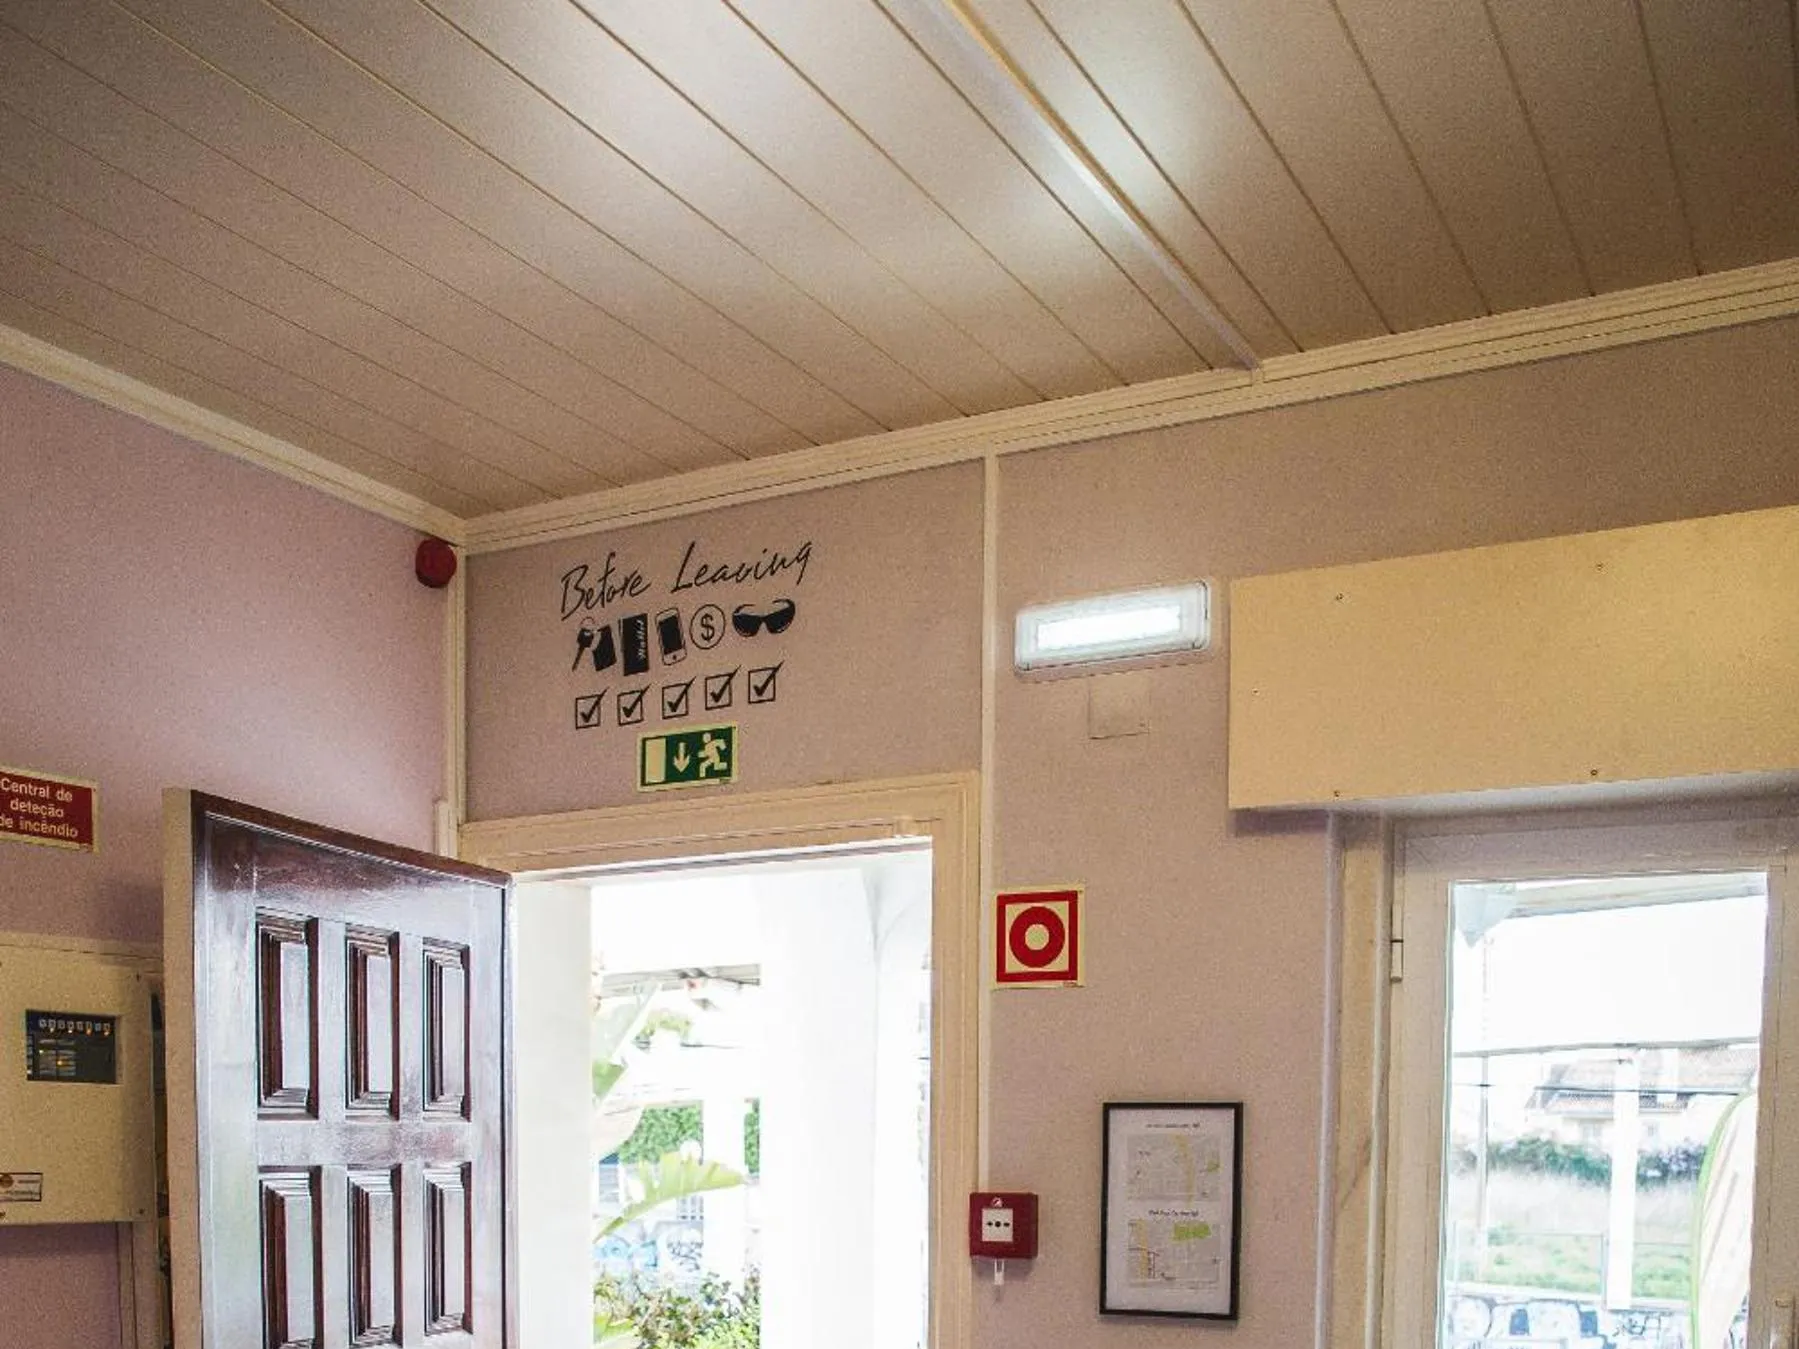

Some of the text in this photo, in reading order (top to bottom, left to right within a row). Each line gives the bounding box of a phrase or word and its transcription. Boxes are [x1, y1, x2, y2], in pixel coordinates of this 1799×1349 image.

[560, 541, 813, 621] Before Leaving
[0, 777, 73, 803] Central de
[10, 798, 64, 818] deteção
[20, 816, 79, 838] incêndio
